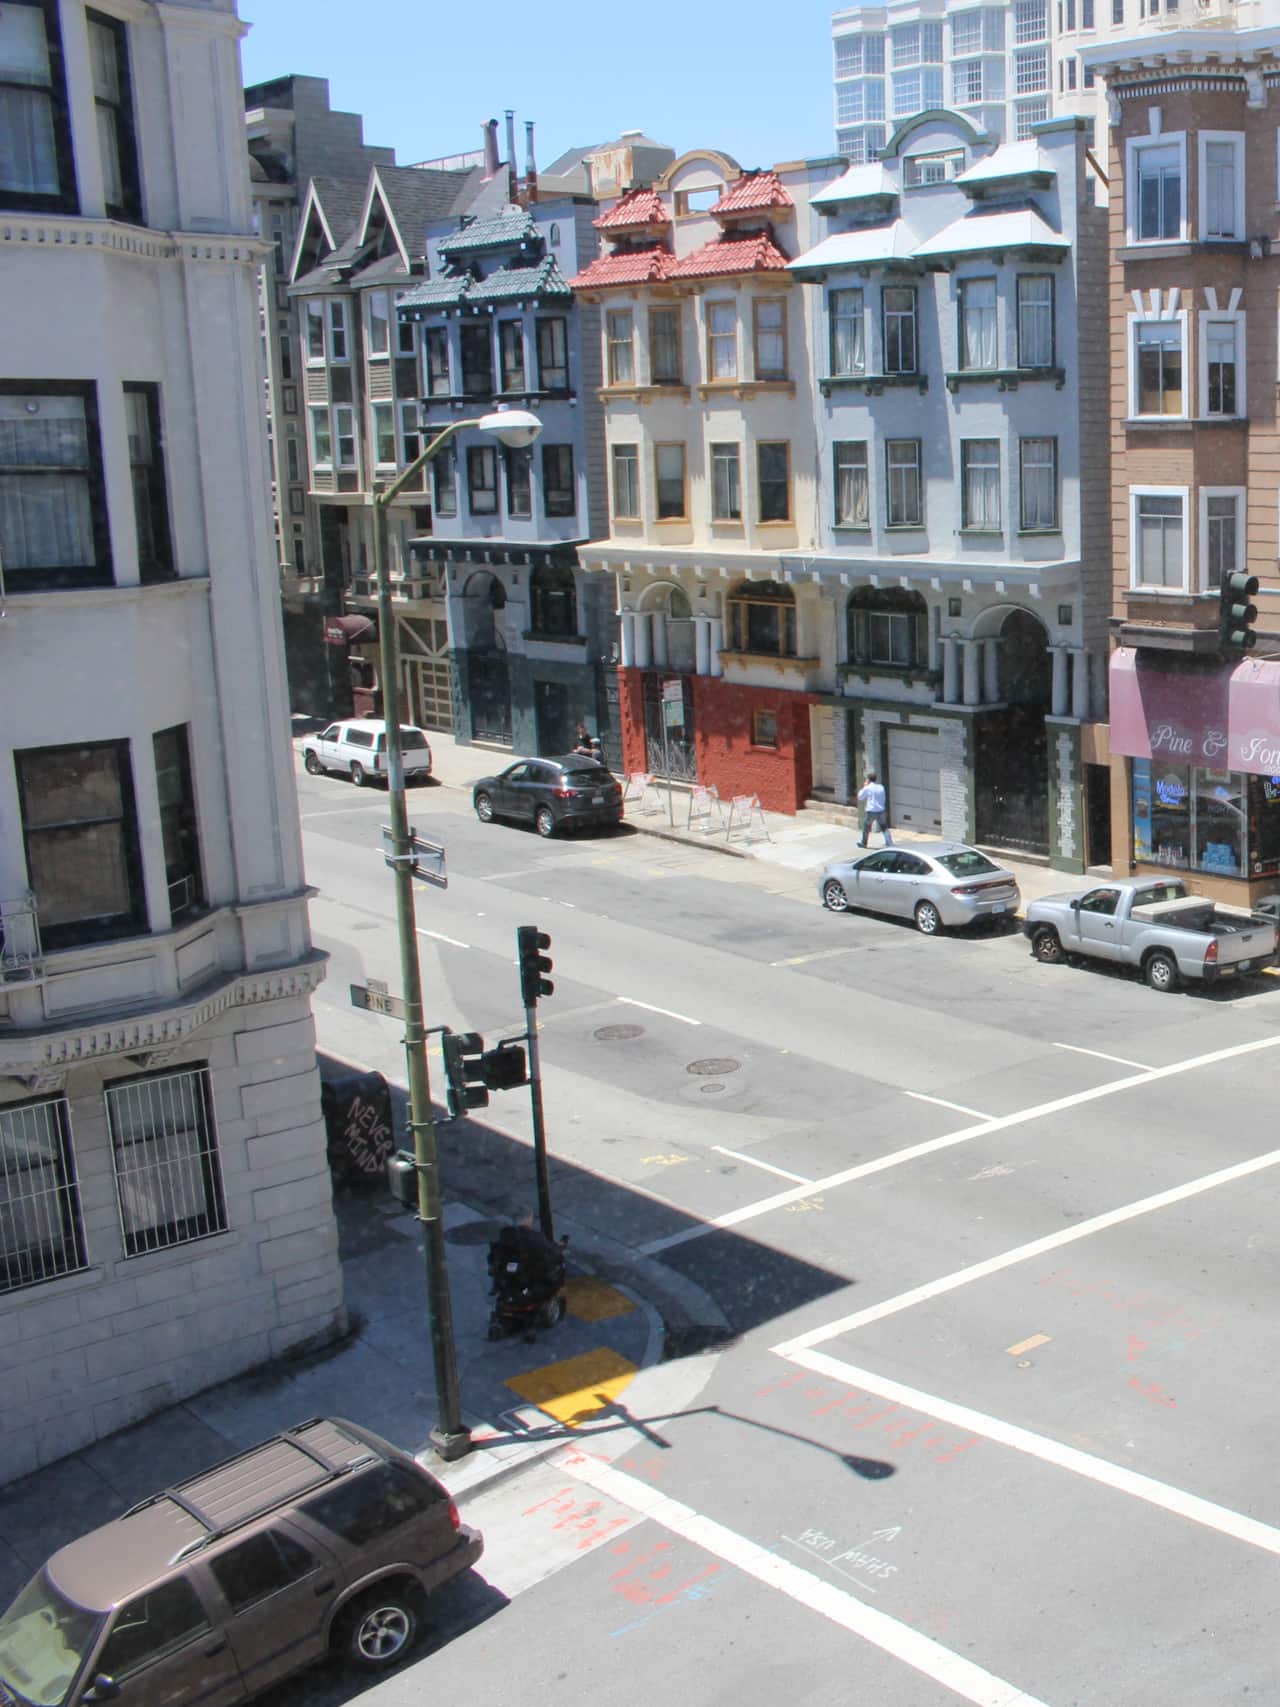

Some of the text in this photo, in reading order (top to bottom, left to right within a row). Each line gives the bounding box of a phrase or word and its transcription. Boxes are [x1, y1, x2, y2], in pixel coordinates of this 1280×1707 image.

[1152, 725, 1193, 753] Pine
[1203, 731, 1227, 757] &
[365, 993, 392, 1011] PINE
[347, 1096, 393, 1166] NEVER
